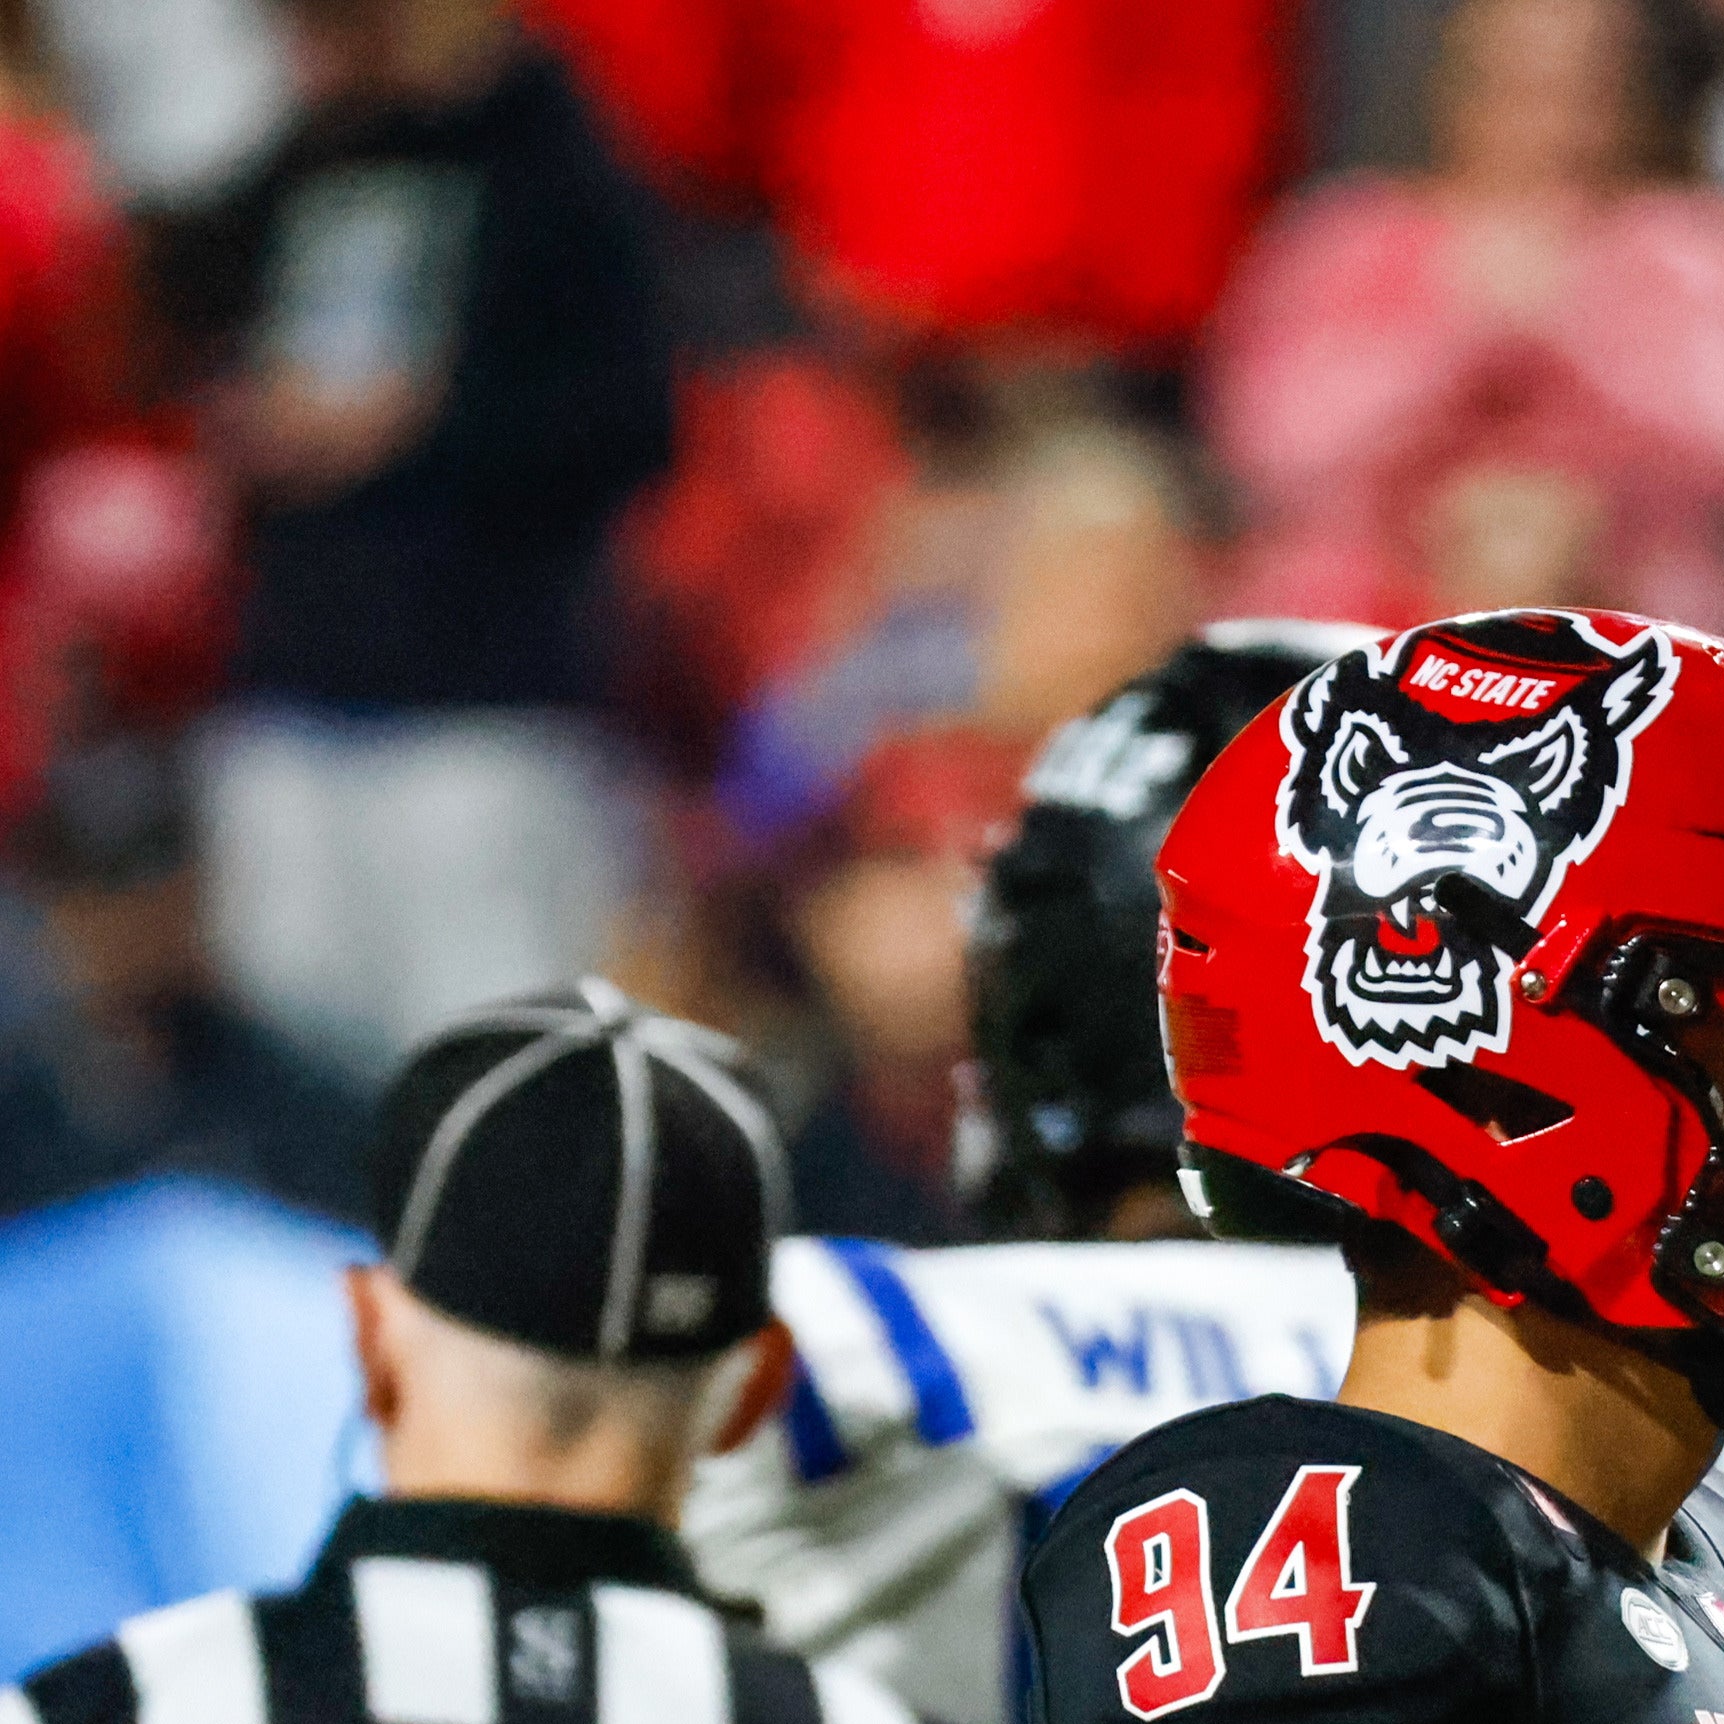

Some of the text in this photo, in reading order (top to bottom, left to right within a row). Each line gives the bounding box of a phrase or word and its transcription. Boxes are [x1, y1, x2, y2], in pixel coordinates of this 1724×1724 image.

[1409, 653, 1558, 710] NC STATE
[1103, 1464, 1378, 1722] 94
